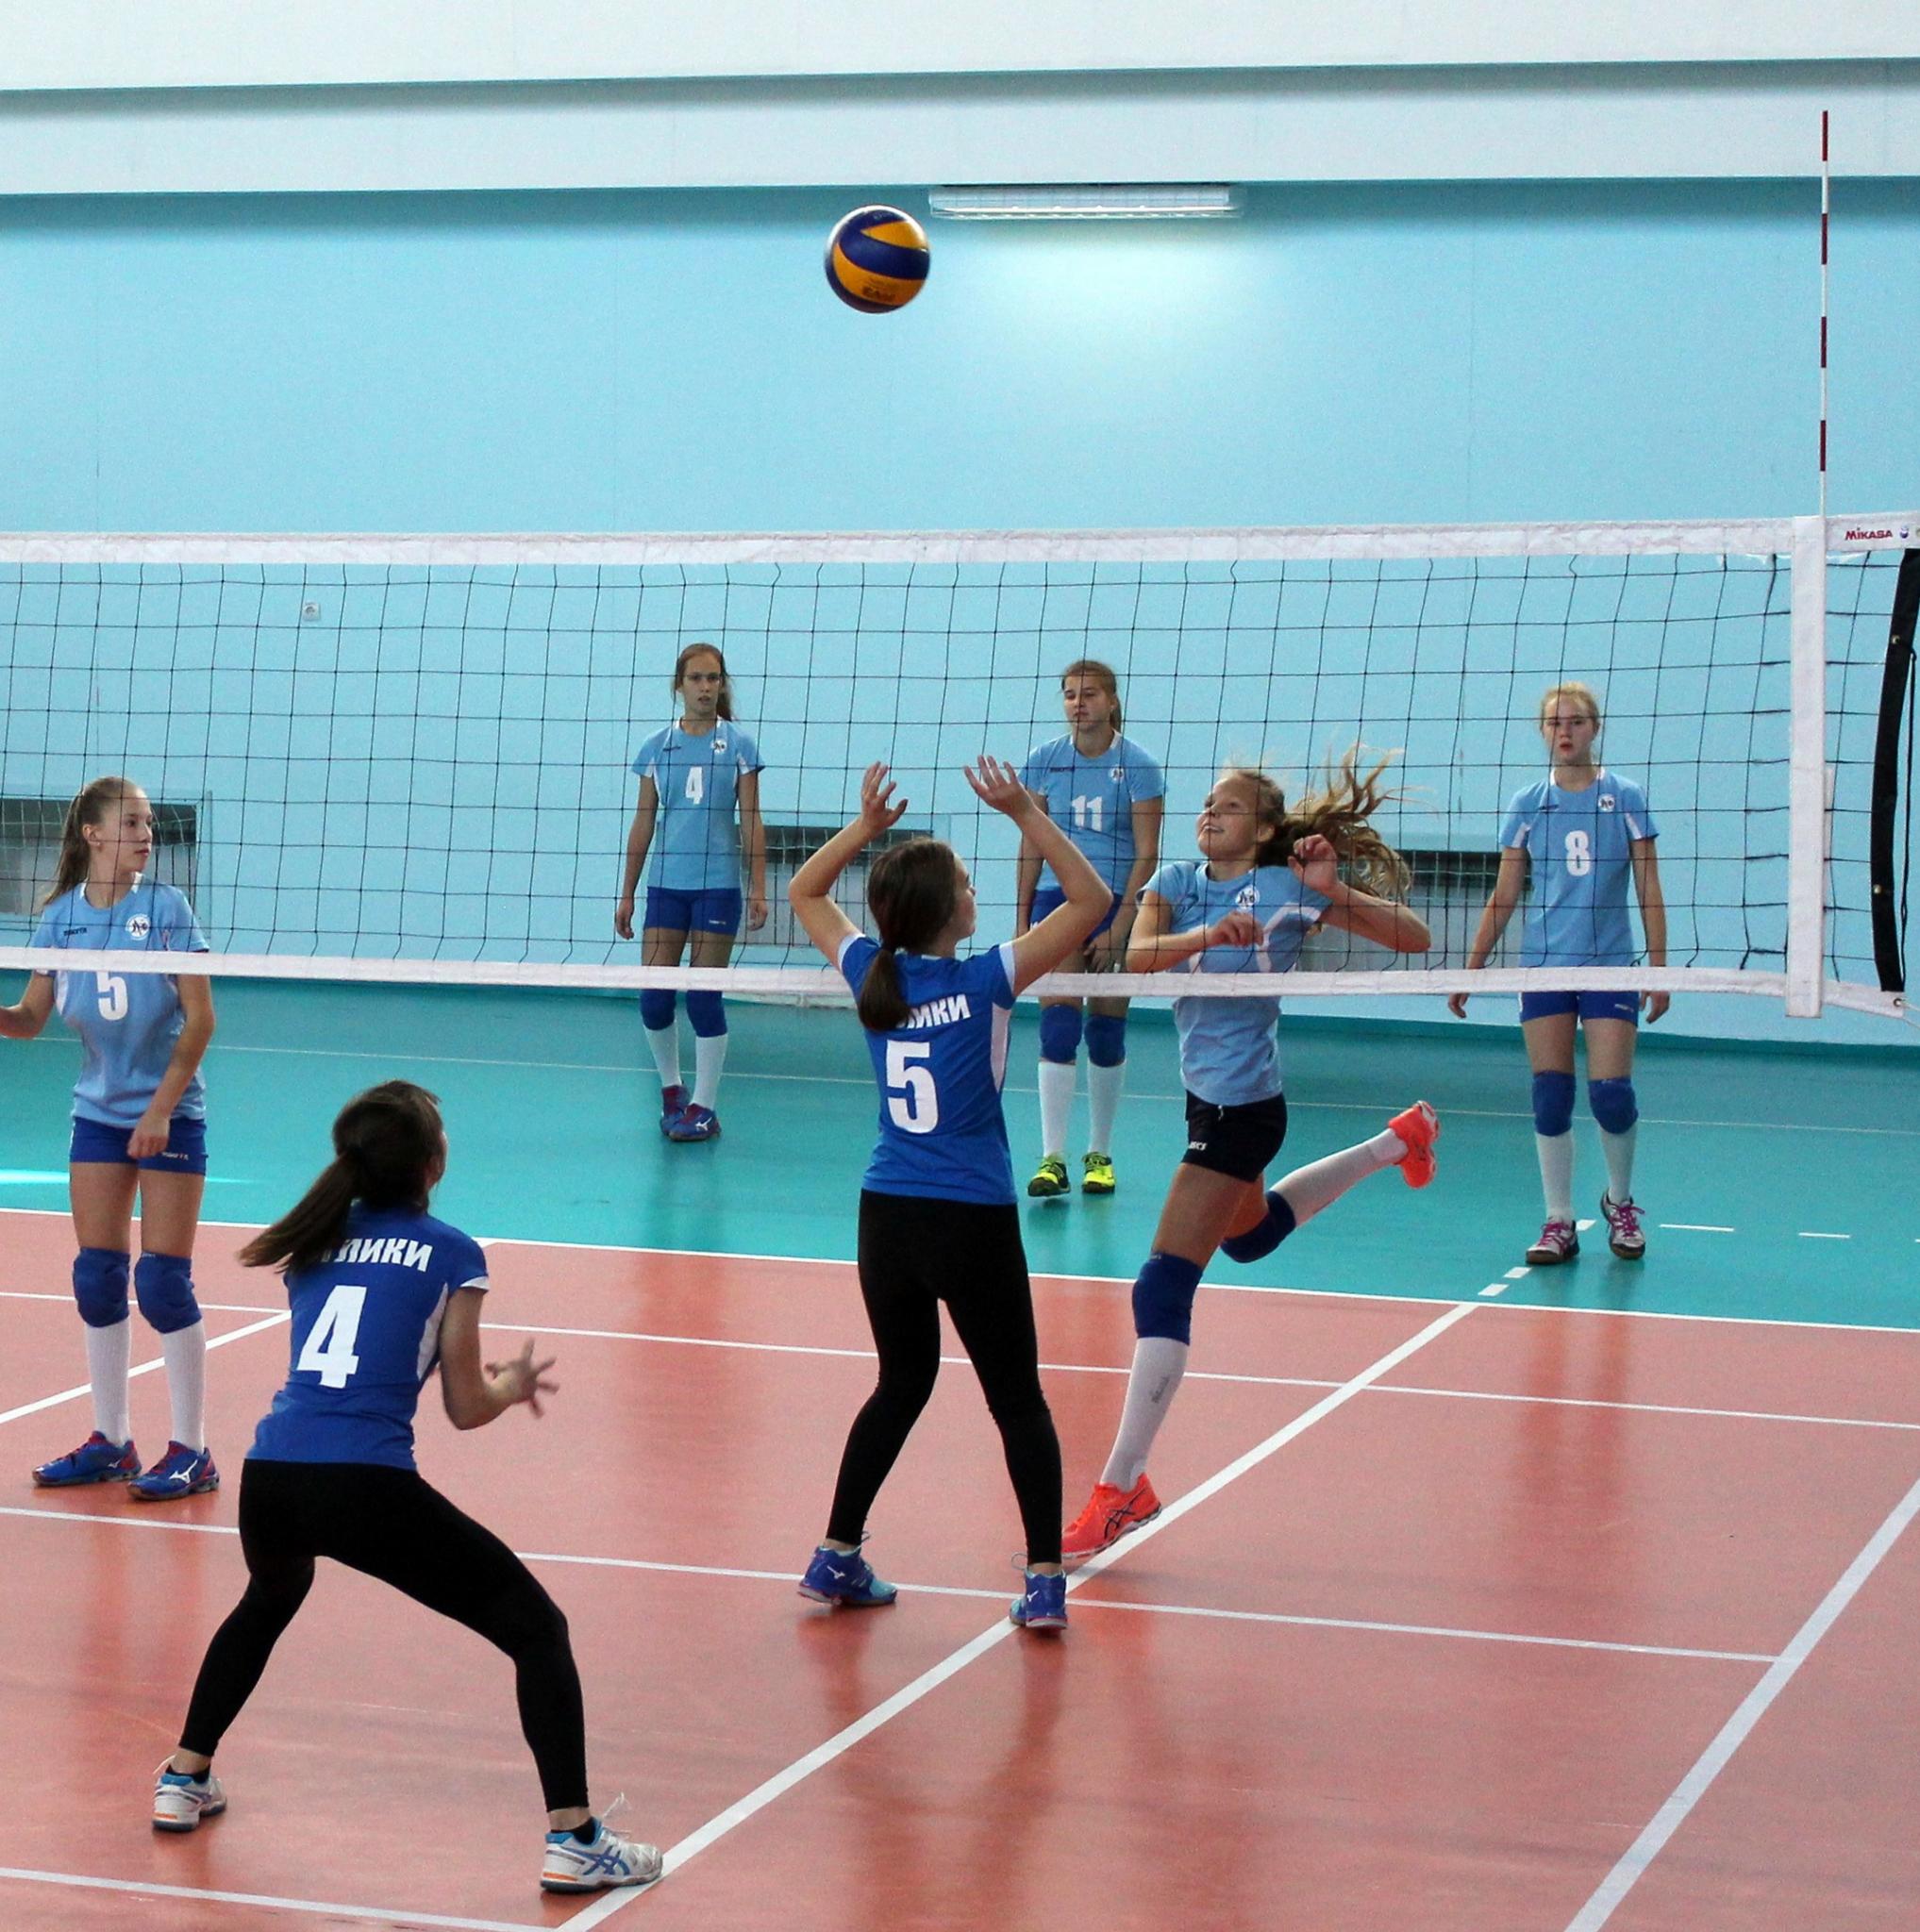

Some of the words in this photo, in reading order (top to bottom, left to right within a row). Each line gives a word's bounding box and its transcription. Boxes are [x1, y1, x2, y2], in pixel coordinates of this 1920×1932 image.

[685, 766, 703, 805] 4
[1072, 794, 1102, 831] 11
[1565, 830, 1591, 876] 8
[96, 971, 128, 1021] 5
[886, 1039, 939, 1134] 5
[296, 1284, 367, 1389] 4
